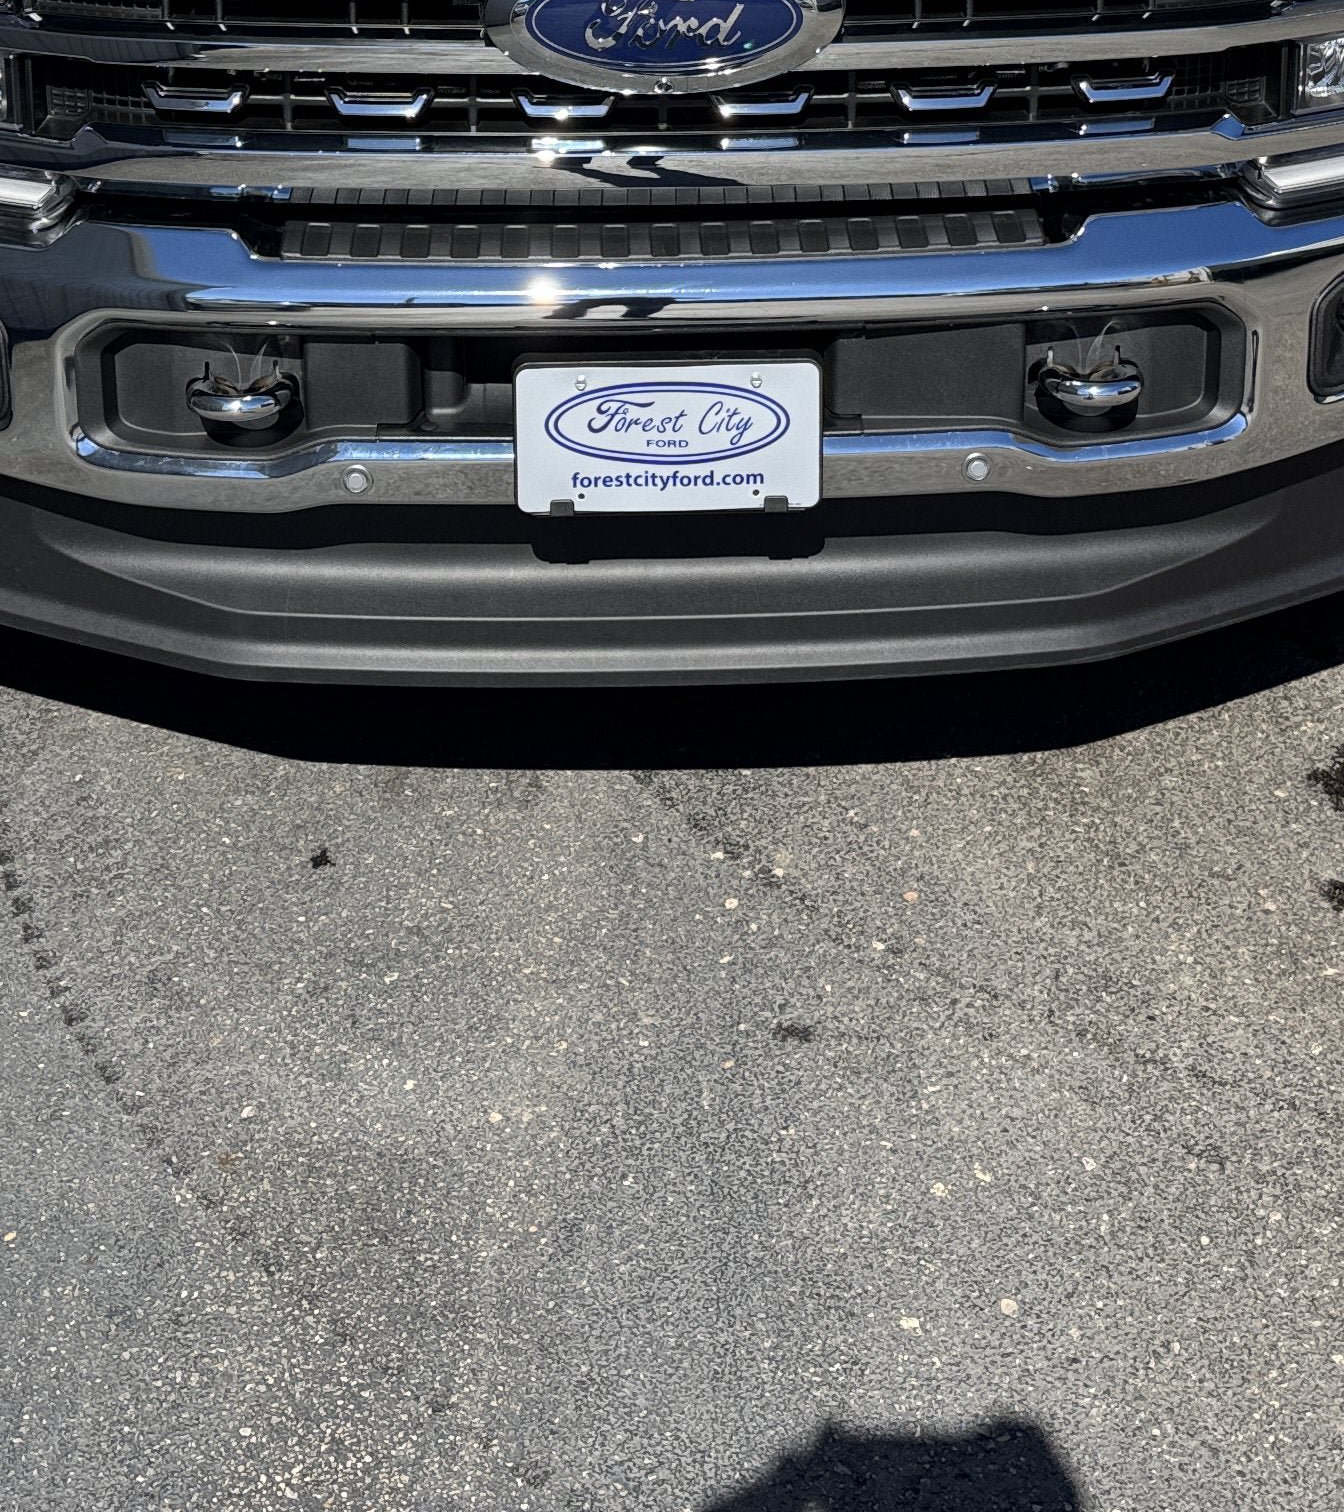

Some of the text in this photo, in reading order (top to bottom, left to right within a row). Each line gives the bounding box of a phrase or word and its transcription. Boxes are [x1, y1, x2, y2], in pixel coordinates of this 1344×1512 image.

[587, 398, 754, 446] Forest City
[645, 439, 689, 449] FORD
[571, 469, 765, 492] forestcityford.com
